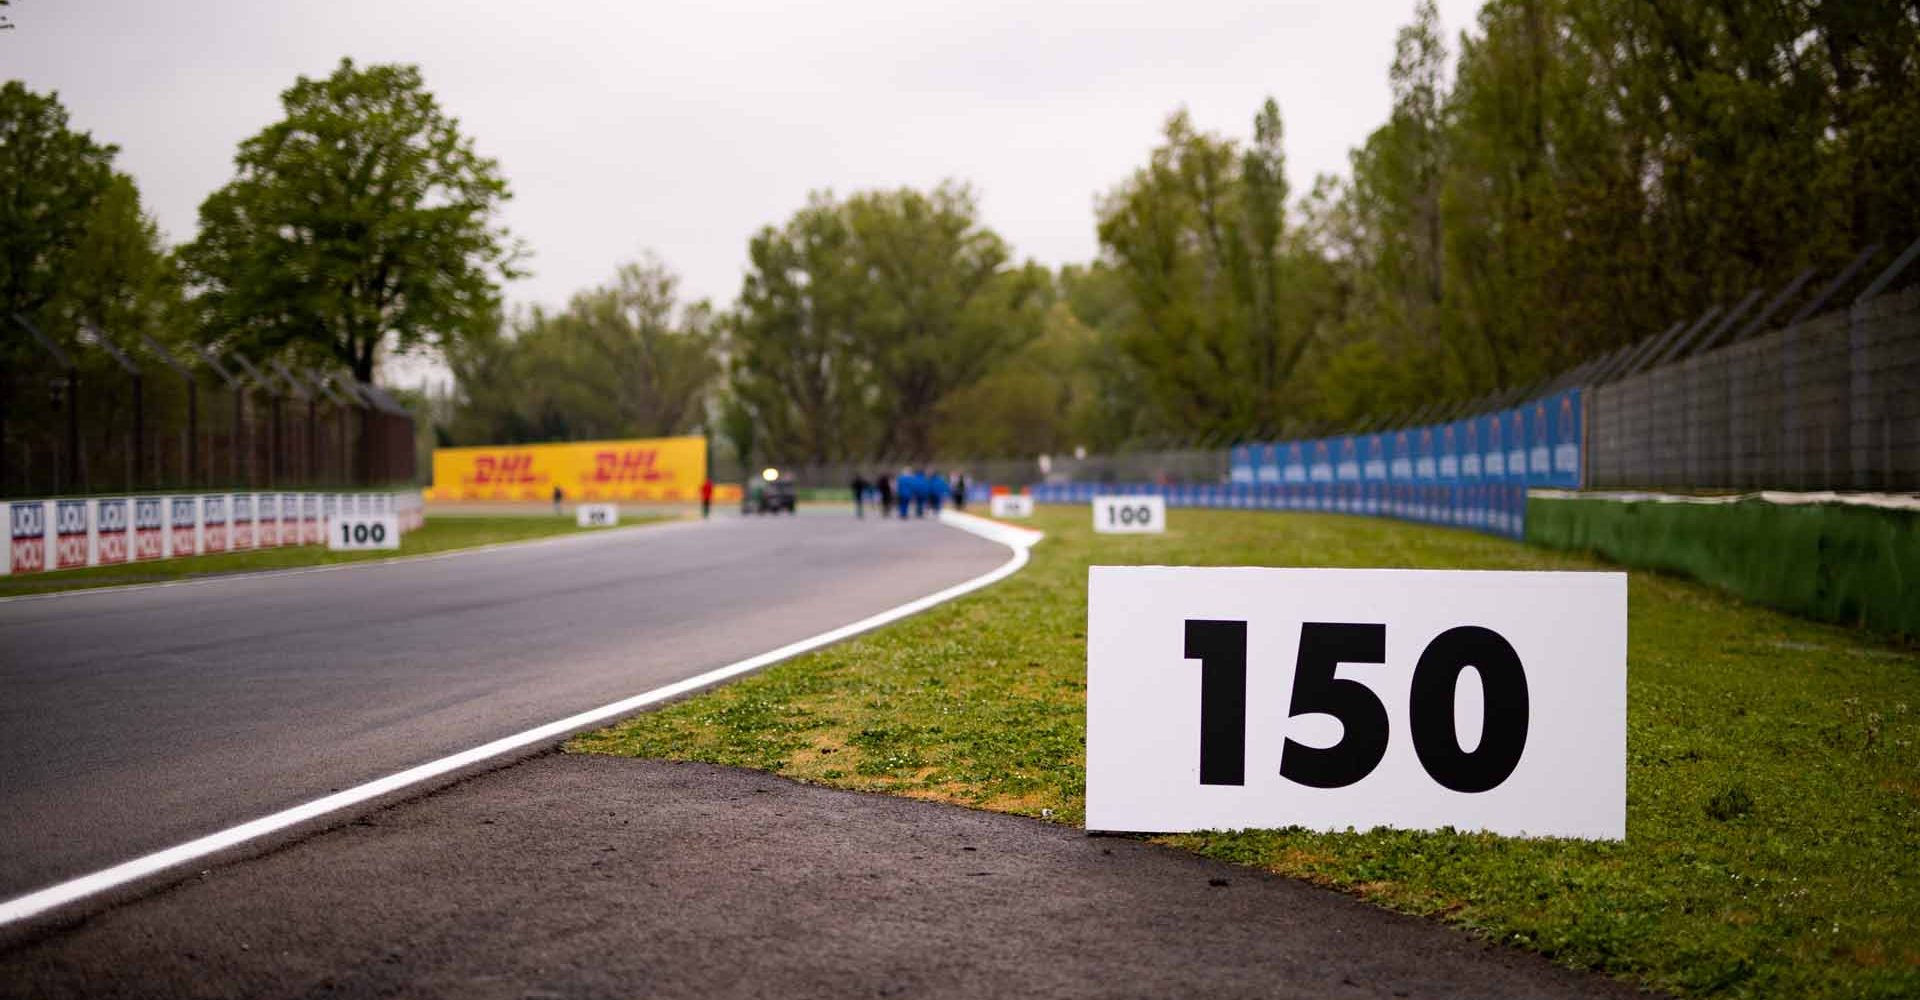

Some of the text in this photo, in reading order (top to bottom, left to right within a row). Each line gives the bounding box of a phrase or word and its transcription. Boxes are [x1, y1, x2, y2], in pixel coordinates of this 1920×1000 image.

[474, 454, 536, 484] DHL
[594, 451, 661, 482] DHL
[1109, 506, 1150, 525] 100
[341, 523, 386, 544] 100
[1184, 620, 1529, 794] 150
